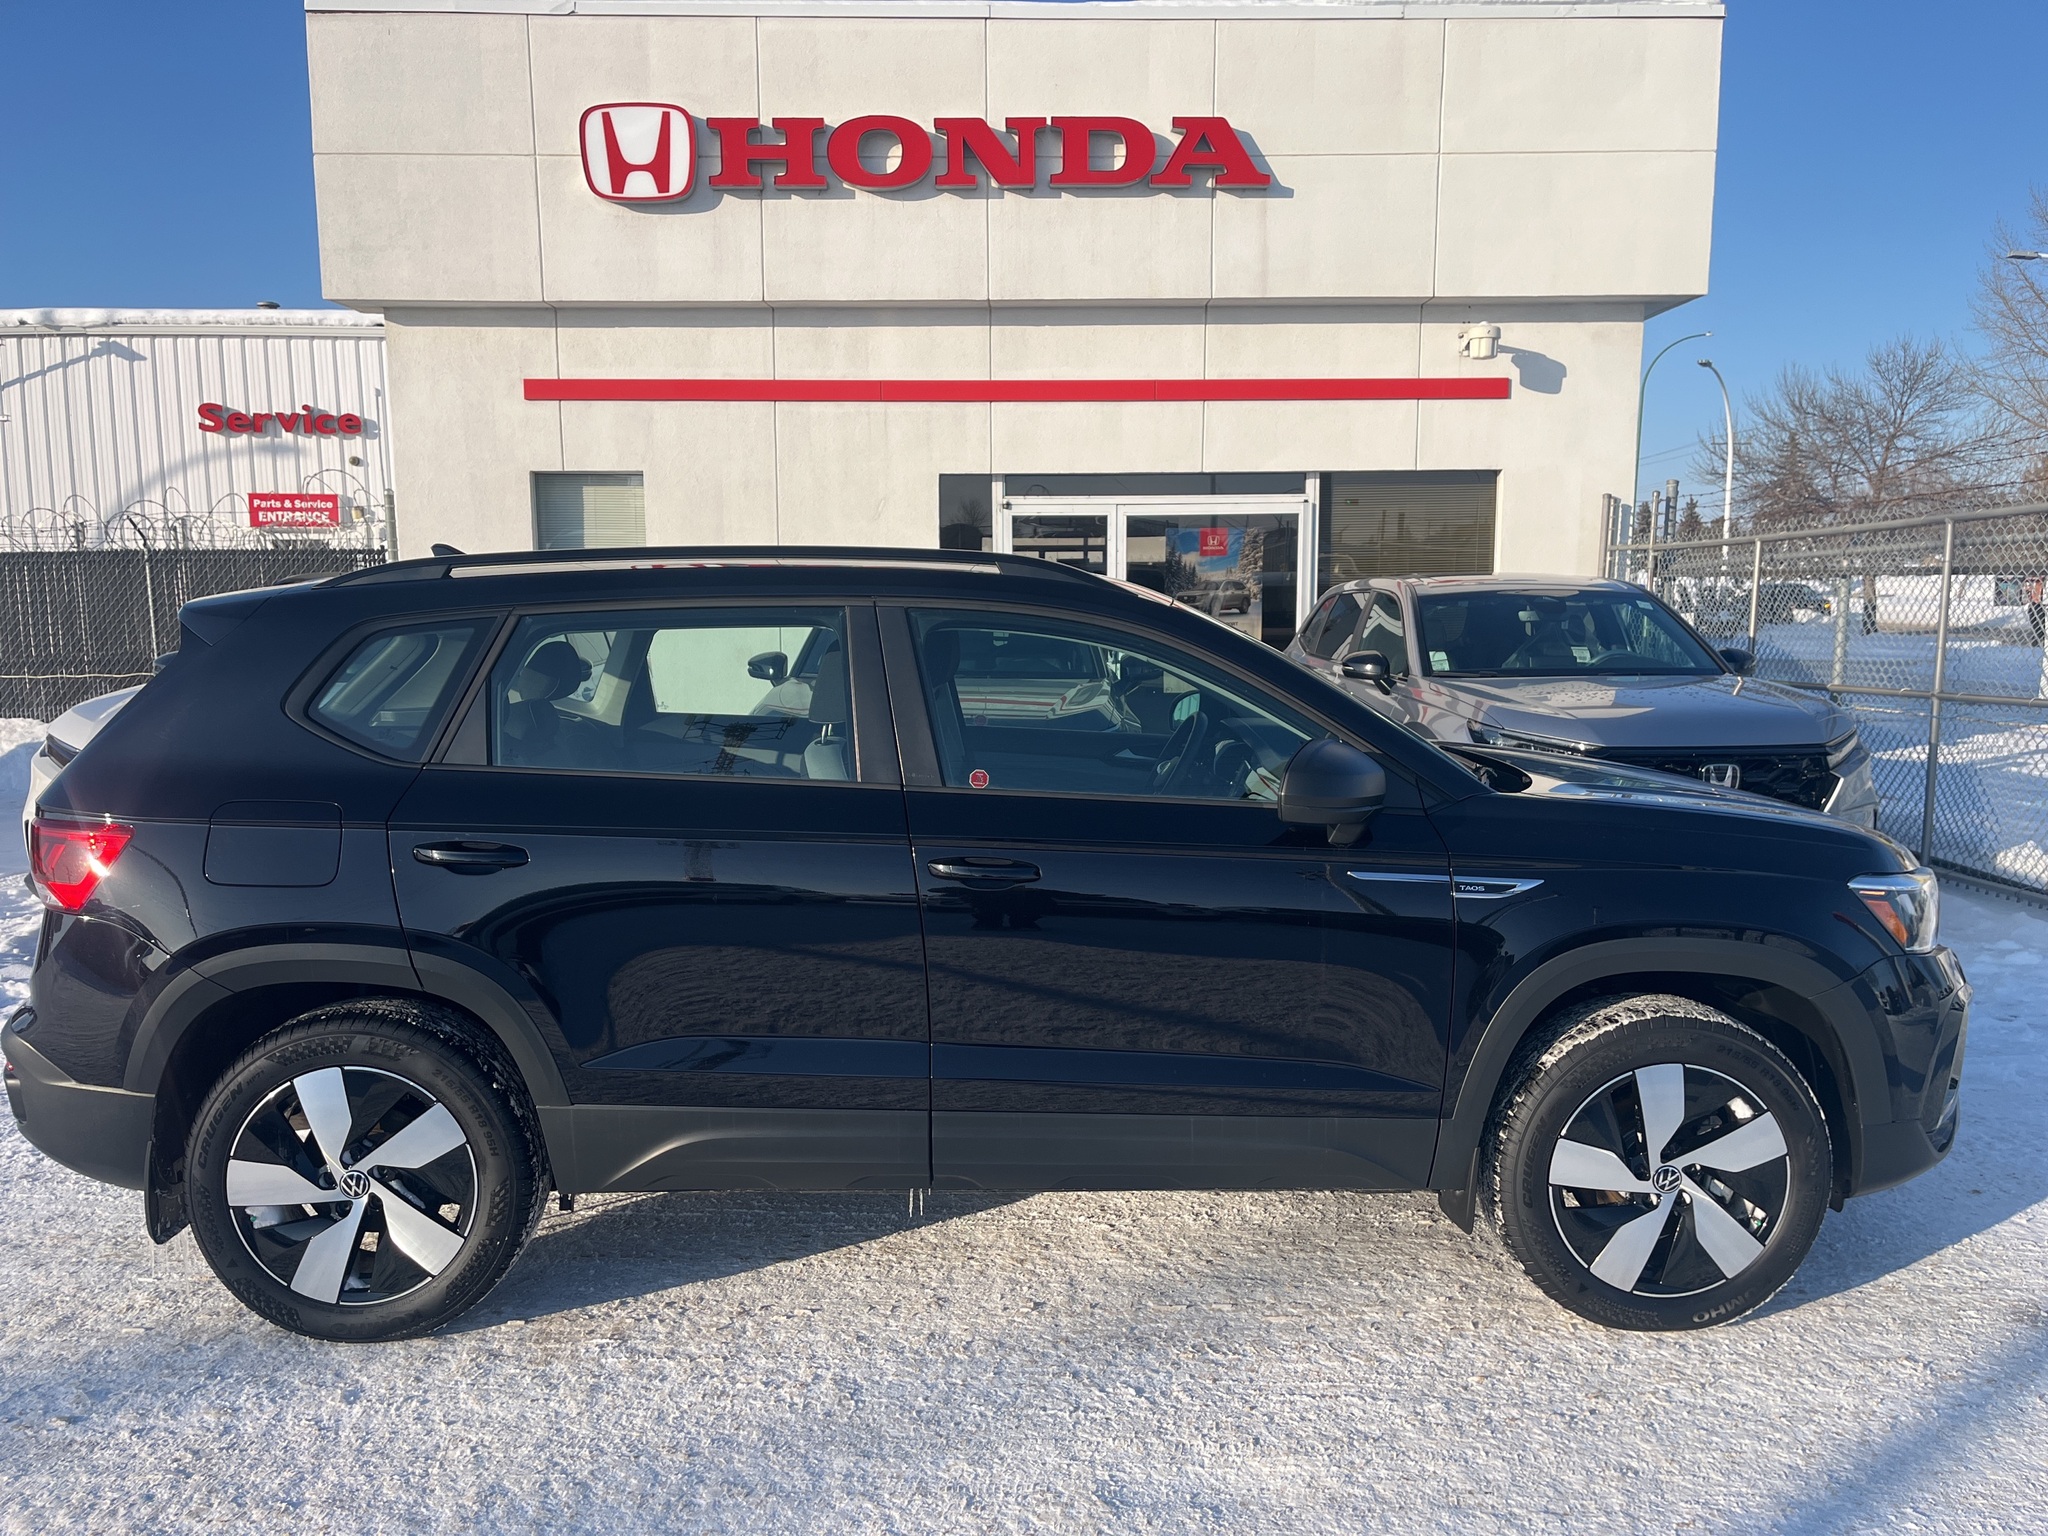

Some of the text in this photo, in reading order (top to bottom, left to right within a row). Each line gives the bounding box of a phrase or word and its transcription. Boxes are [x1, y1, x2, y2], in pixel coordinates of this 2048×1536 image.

[705, 115, 1271, 190] HONDA
[198, 403, 362, 434] Service
[253, 499, 333, 508] Parts & Service
[258, 511, 330, 522] ENTRANCE
[198, 1082, 243, 1169] CRUGEN
[468, 1104, 487, 1128] R18
[484, 1131, 500, 1156] 95H
[1522, 1115, 1547, 1209] CRUGEN
